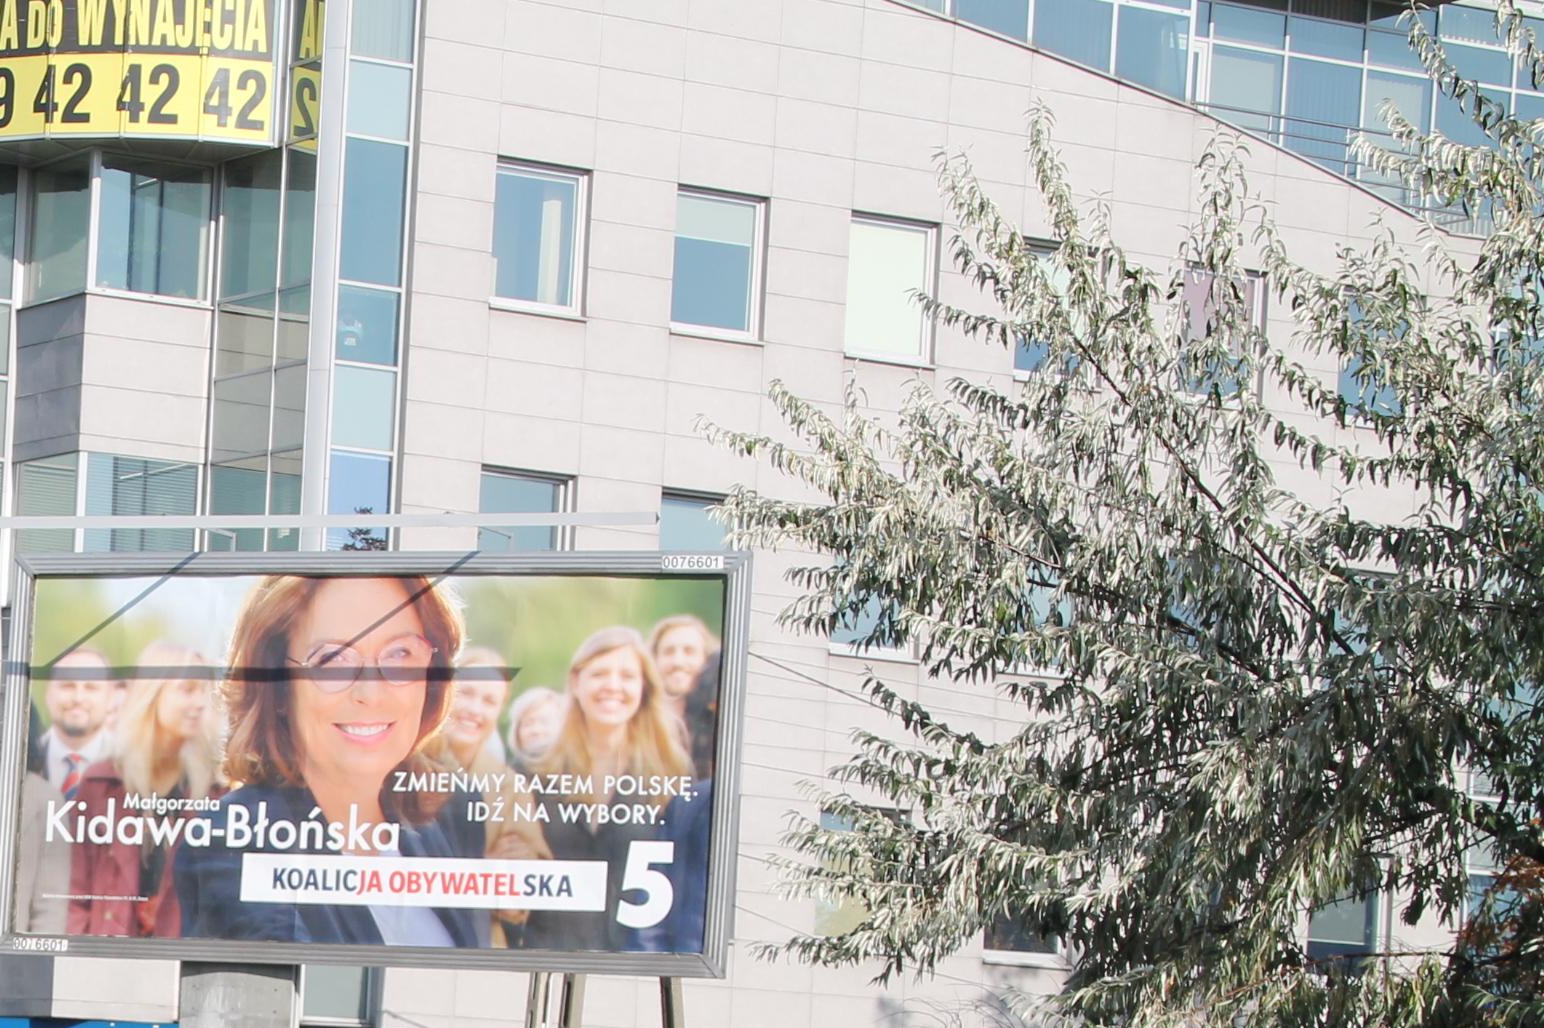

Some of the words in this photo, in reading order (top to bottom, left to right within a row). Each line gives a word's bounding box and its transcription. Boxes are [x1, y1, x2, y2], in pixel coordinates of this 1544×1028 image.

[26, 0, 63, 49] DO
[77, 0, 268, 54] WYNAJĘCIA
[33, 61, 93, 124] 42
[116, 62, 180, 126] 42
[202, 66, 268, 132] 42
[663, 556, 719, 569] 0076601
[392, 767, 506, 794] ZMIEŃMY
[513, 774, 594, 796] RAZEM
[604, 774, 699, 803] POLSKĘ.
[123, 792, 221, 816] Małgorzata
[466, 796, 505, 823] IDŹ
[513, 803, 551, 823] NA
[557, 803, 666, 826] WYBORY.
[45, 798, 401, 851] Kidawa-Błońska
[272, 867, 383, 894] KOALICJA
[388, 871, 573, 898] OBYWATELSKA
[616, 840, 675, 929] 5
